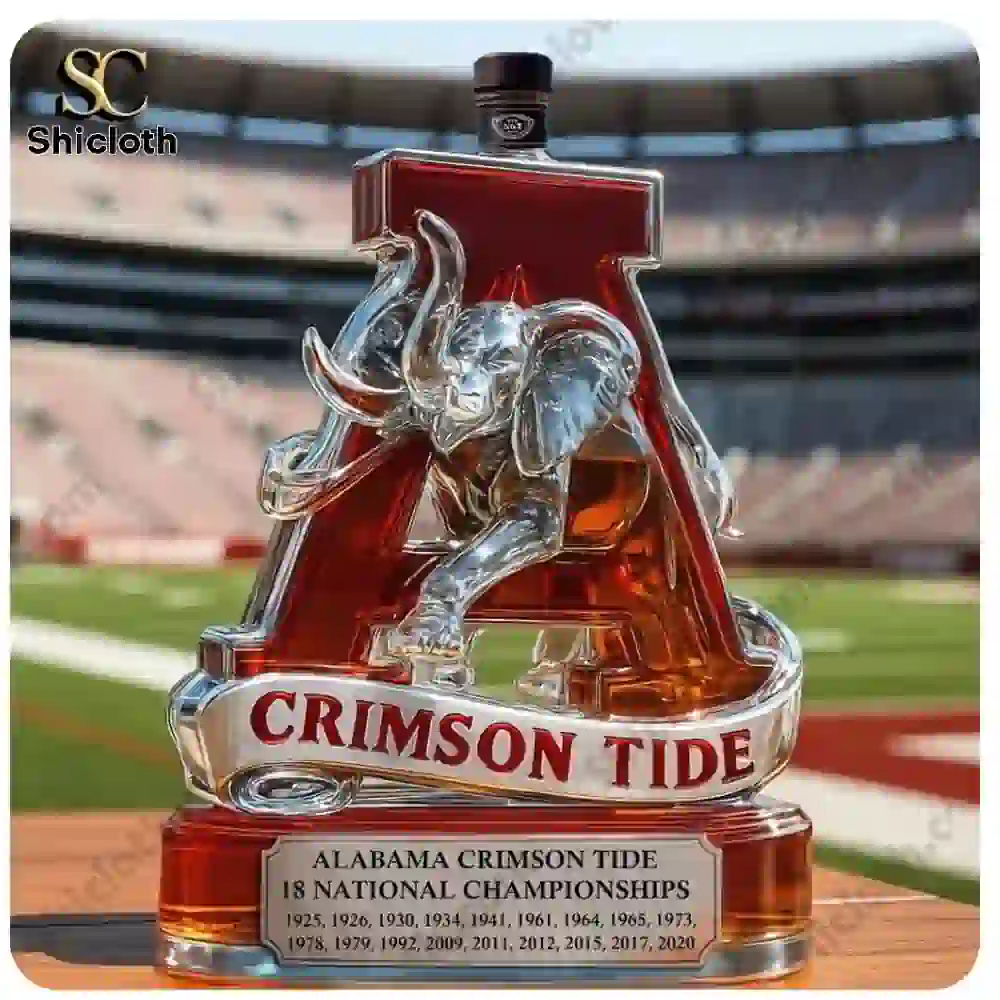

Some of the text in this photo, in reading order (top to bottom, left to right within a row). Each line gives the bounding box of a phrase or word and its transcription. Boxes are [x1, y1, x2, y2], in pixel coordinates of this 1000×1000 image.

[249, 690, 756, 790] CRIMSON TIDE
[312, 849, 659, 870] ALABAMA CRIMSON TIDE
[283, 879, 691, 900] 18 NATIONAL CHAMPIONSHIPS
[286, 912, 697, 930] 1925, 1926, 1930, 1934, 1941, 1961, 1964, 1965, 1973,
[288, 935, 696, 953] 1978, 1979, 1992, 2009, 2011, 2012, 2015, 2017, 2020
